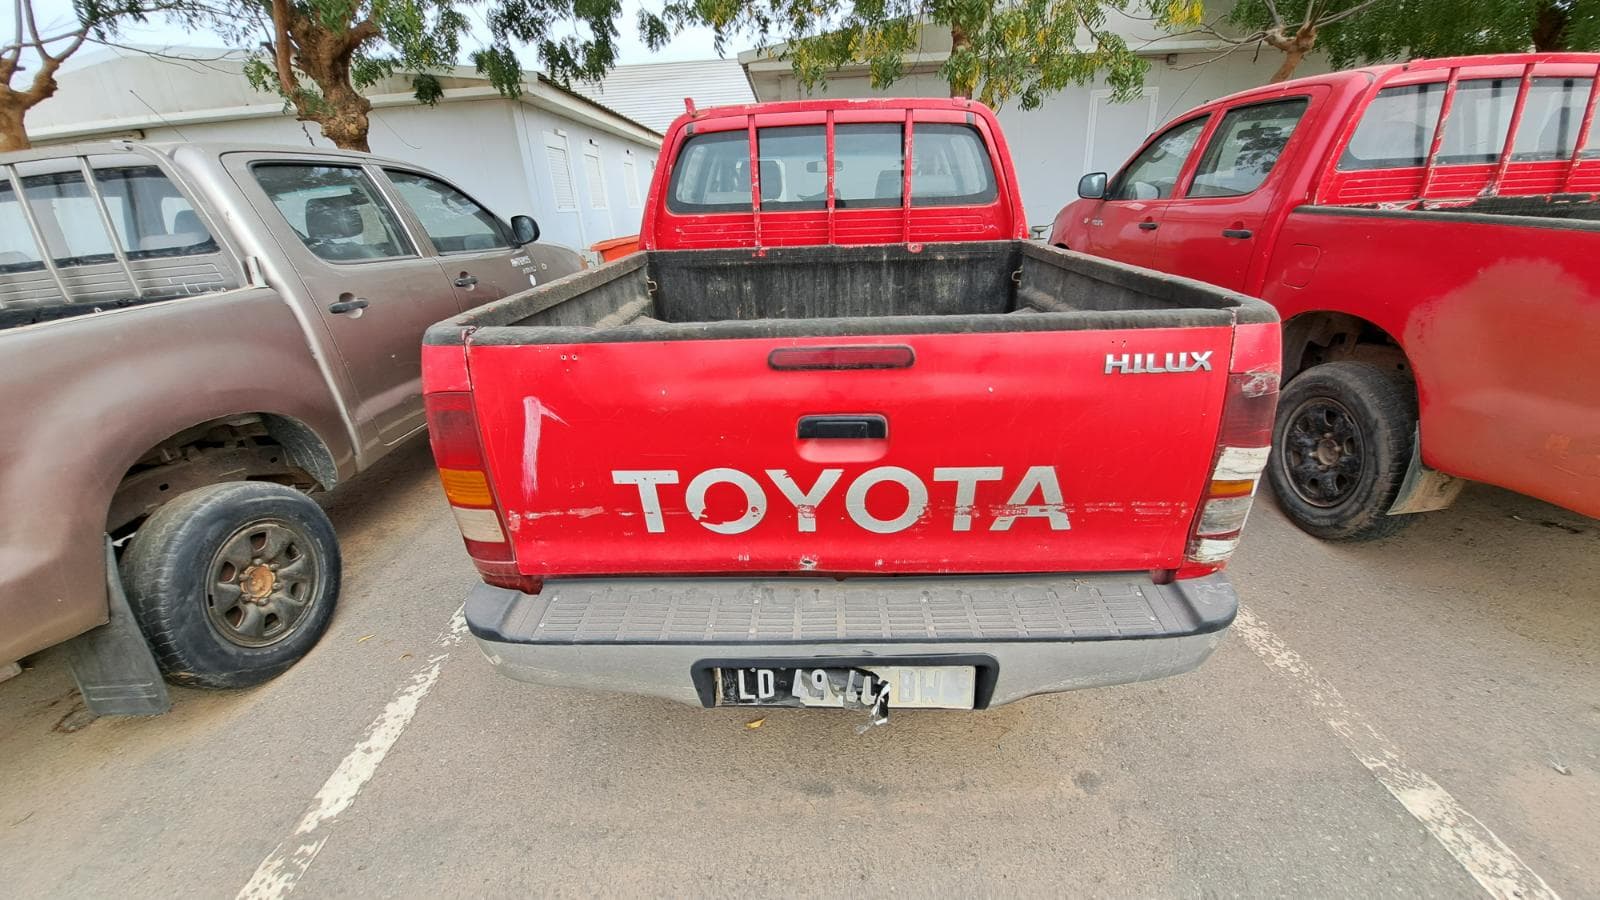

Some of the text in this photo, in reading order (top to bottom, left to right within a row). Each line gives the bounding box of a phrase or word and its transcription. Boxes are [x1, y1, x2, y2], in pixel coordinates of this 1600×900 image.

[1104, 351, 1213, 374] HILUX
[611, 466, 1072, 534] TOYOTA
[737, 669, 774, 700] LD
